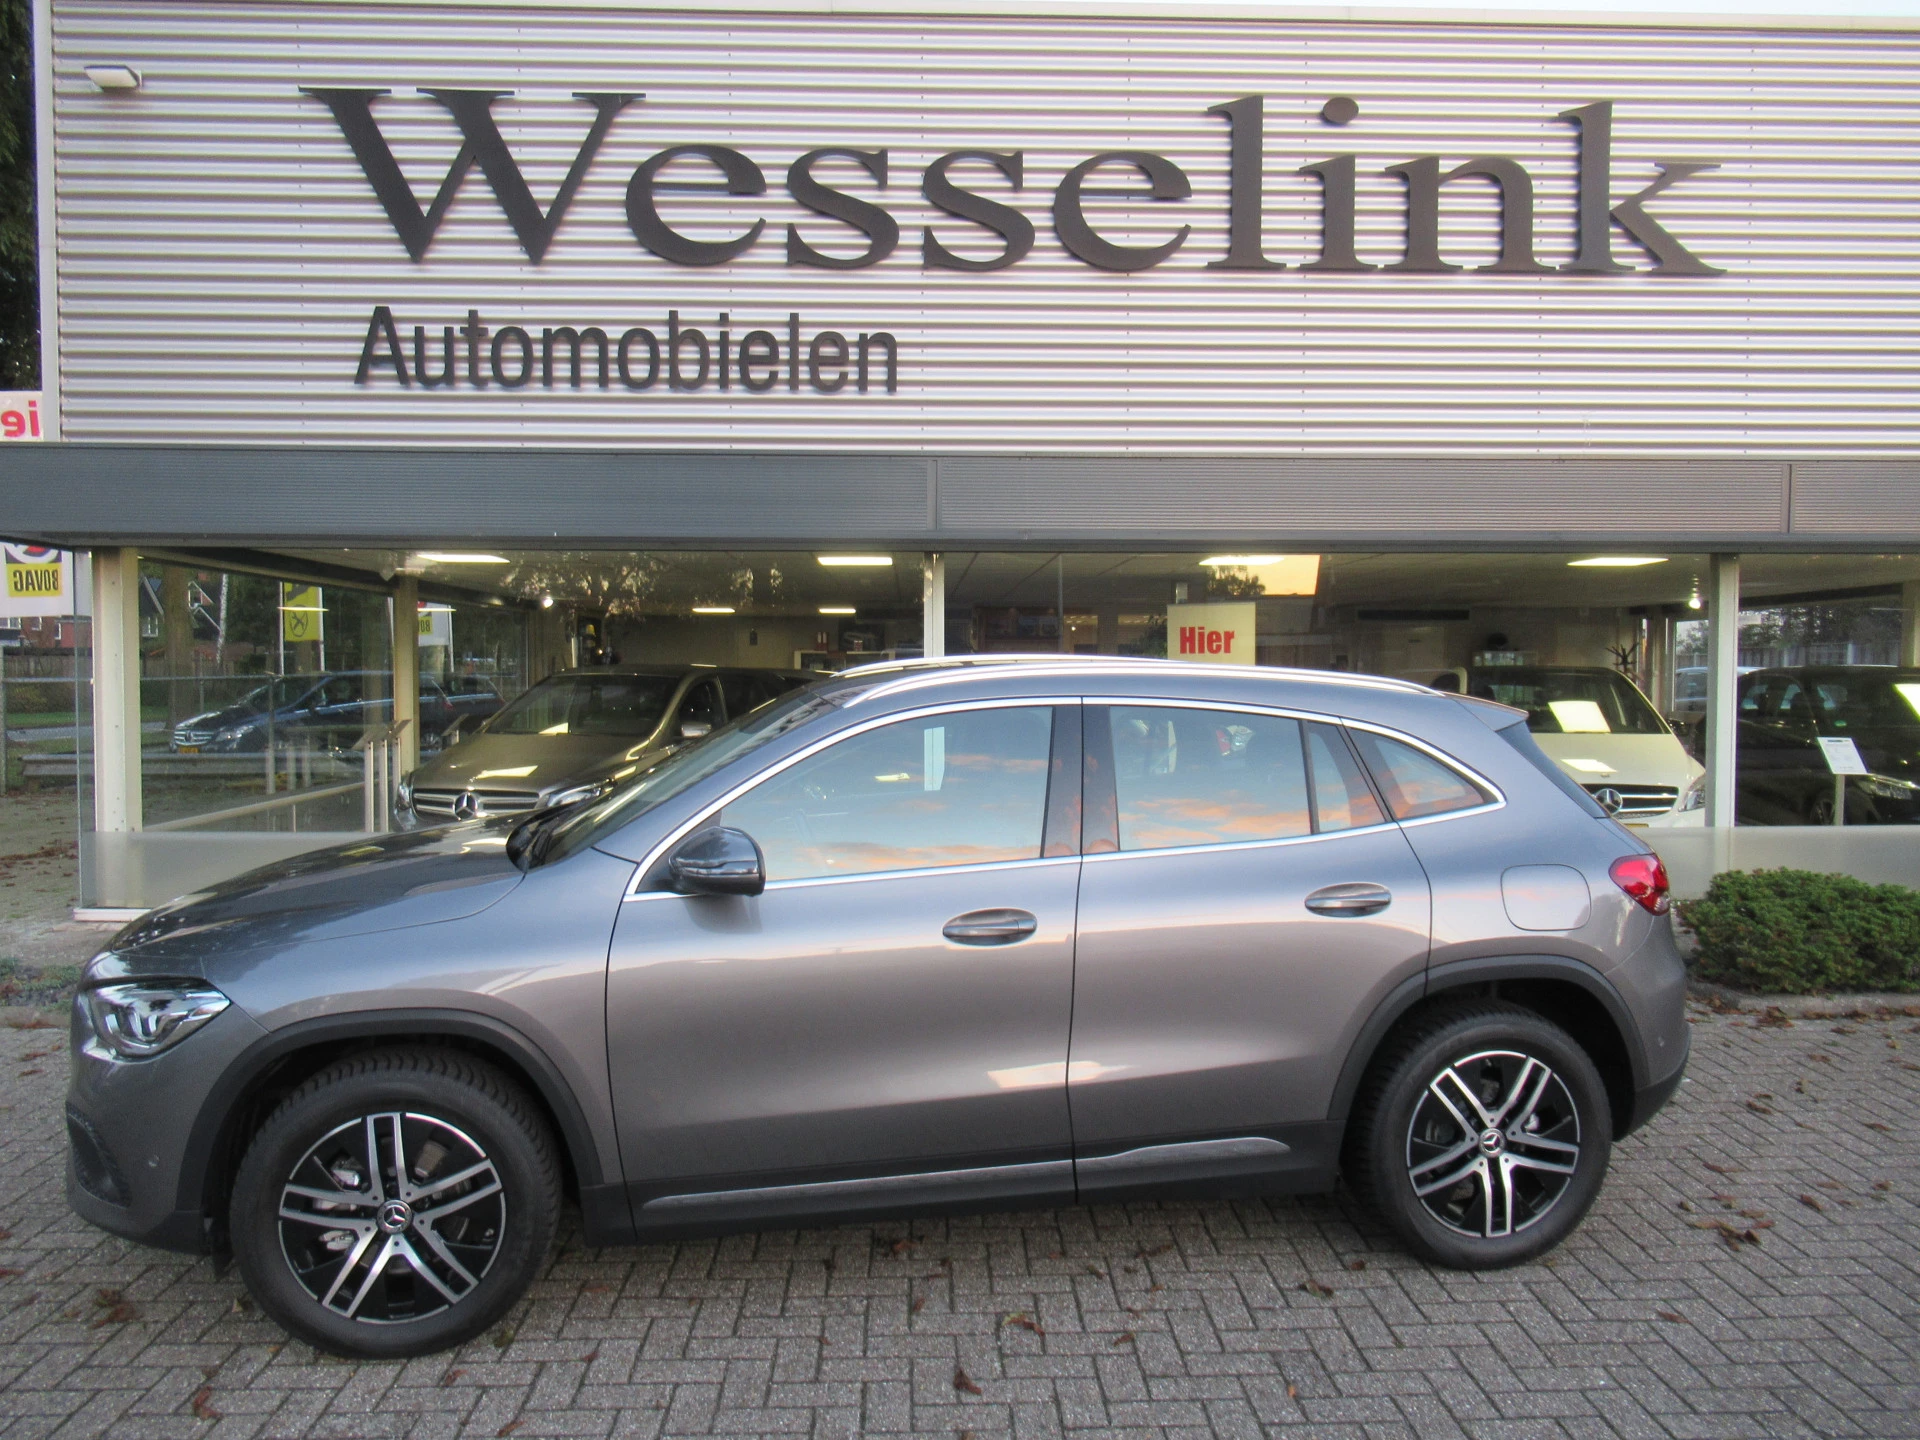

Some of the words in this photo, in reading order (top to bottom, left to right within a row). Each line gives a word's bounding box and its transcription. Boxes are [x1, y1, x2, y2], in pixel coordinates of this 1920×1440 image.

[298, 85, 1727, 276] Wesselink
[354, 305, 898, 394] Automobielen
[1179, 626, 1235, 655] Hier
